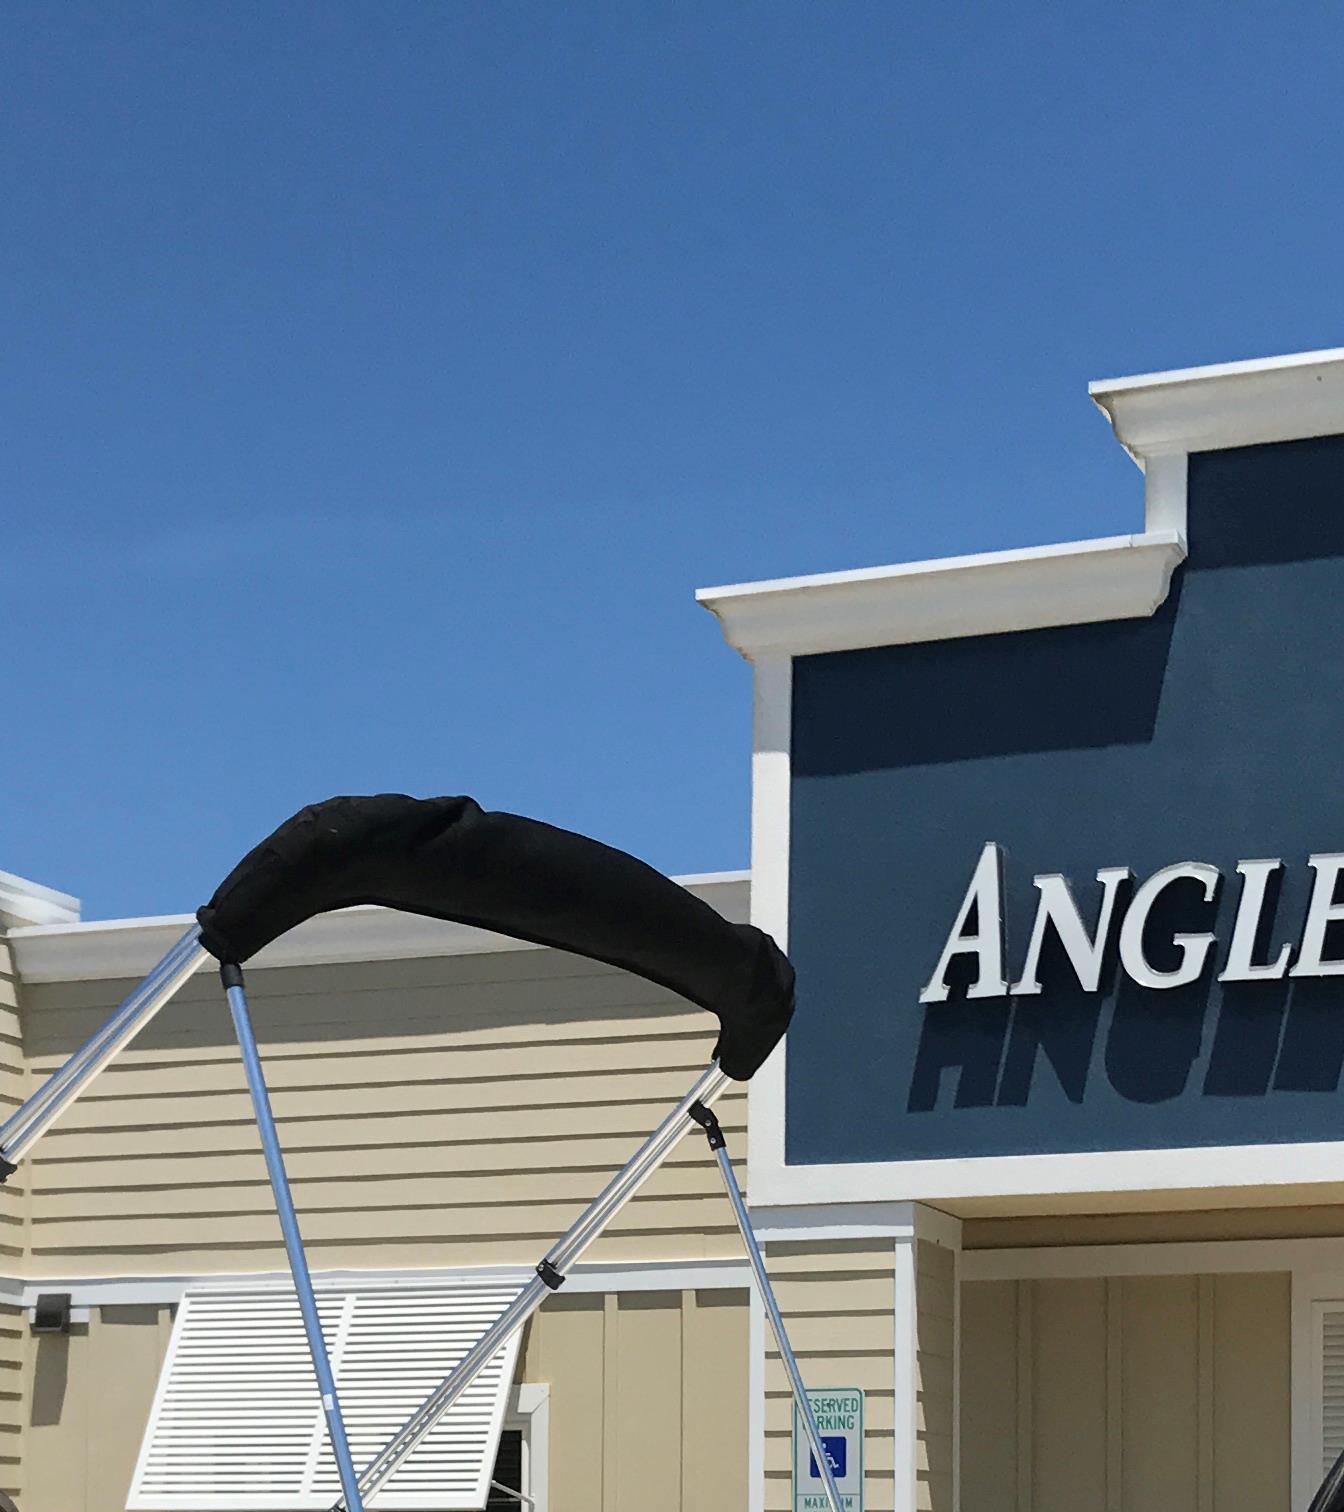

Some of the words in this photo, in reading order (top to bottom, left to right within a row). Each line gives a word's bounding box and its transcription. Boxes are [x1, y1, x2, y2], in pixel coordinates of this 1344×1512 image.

[806, 1397, 859, 1414] SERVED
[809, 1414, 855, 1431] RKING
[804, 1497, 853, 1509] MAXIM
